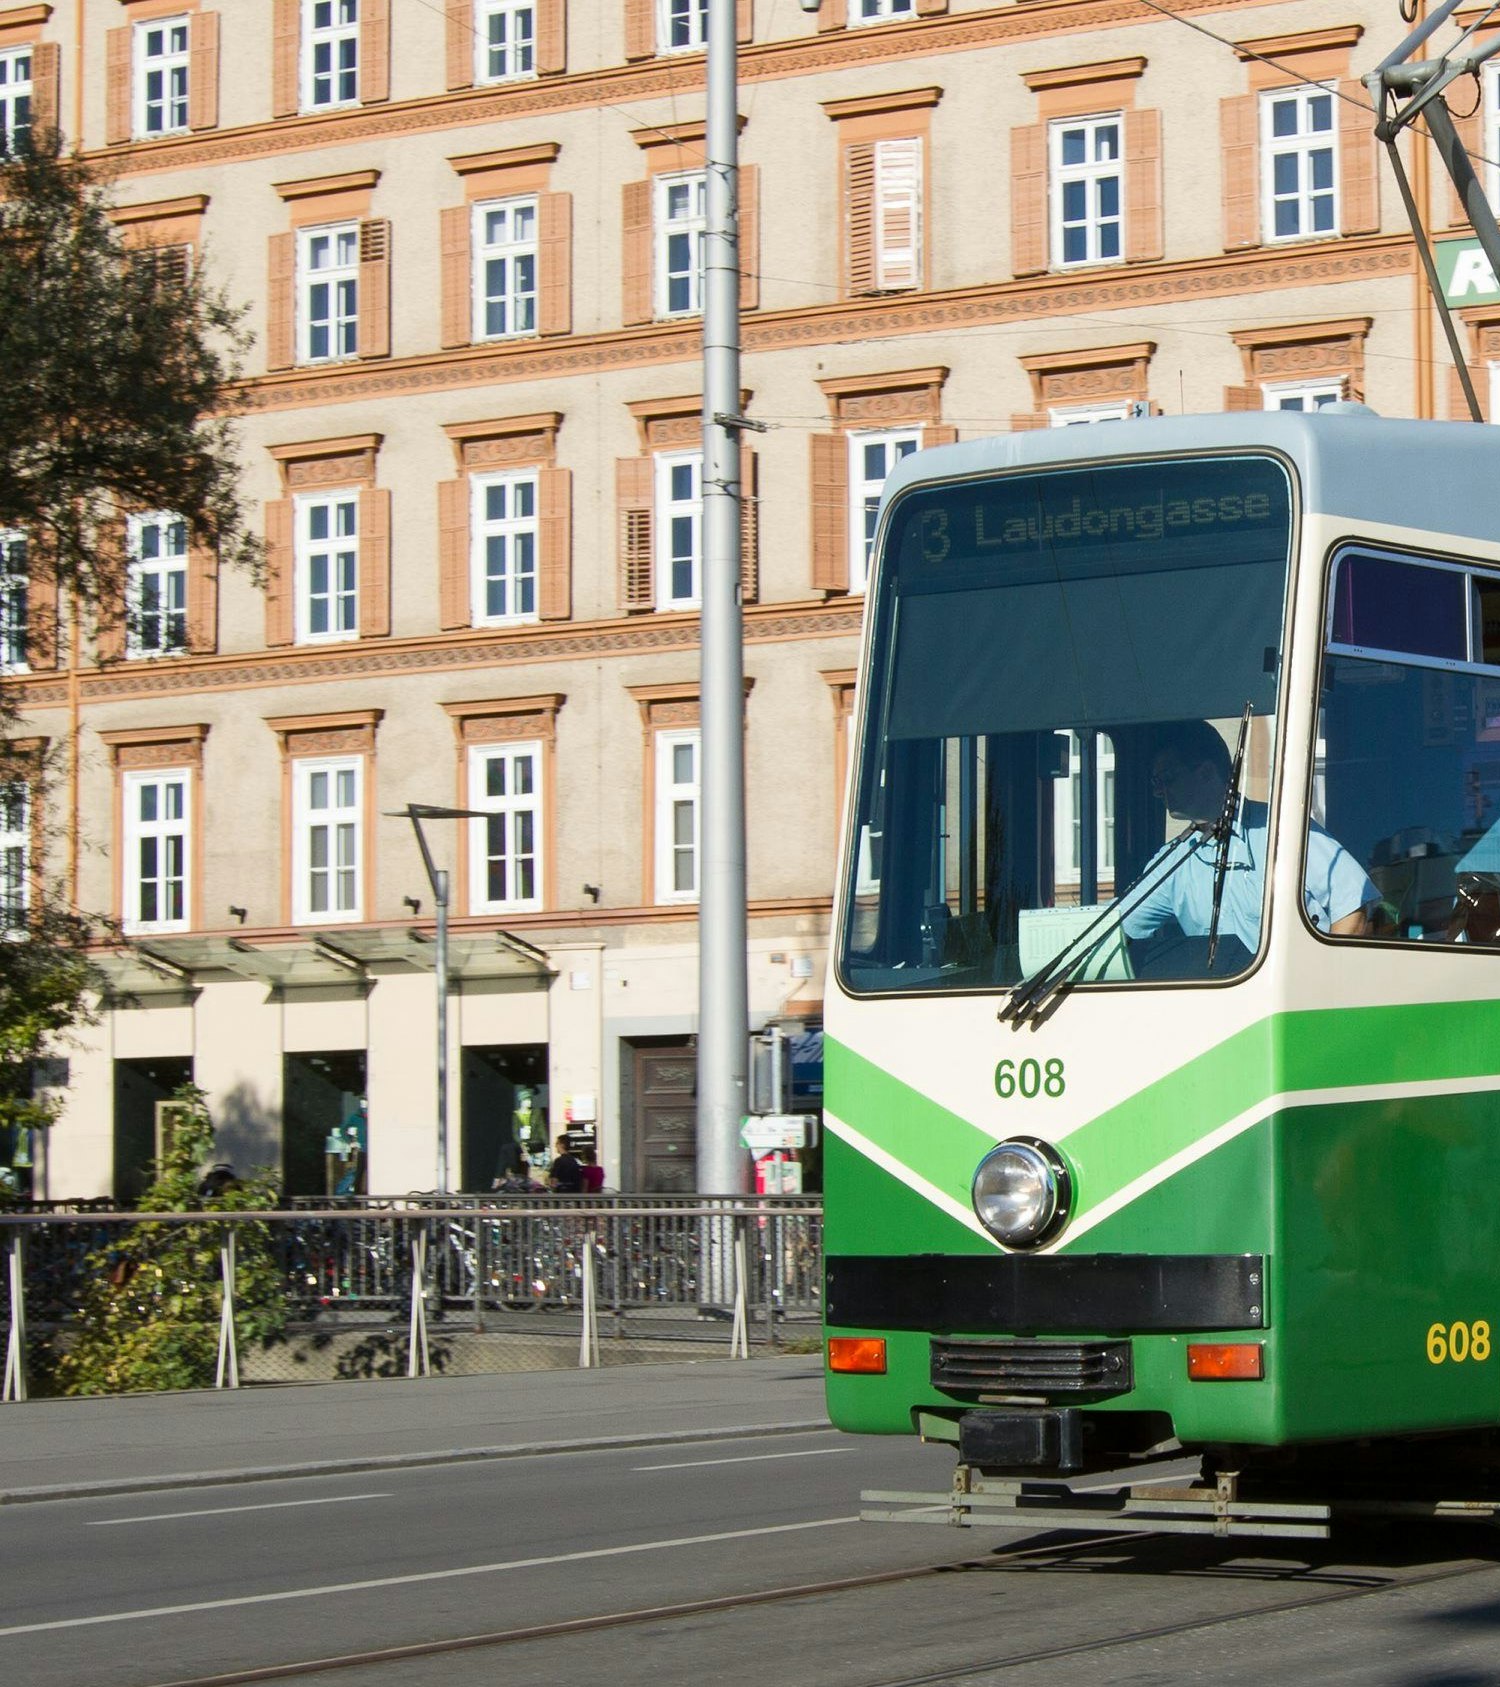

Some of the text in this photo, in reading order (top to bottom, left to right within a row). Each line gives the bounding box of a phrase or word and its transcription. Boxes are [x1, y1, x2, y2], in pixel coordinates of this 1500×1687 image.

[921, 493, 1271, 563] 3 Laudongasse
[994, 1057, 1066, 1099] 608
[1426, 1320, 1491, 1365] 608
